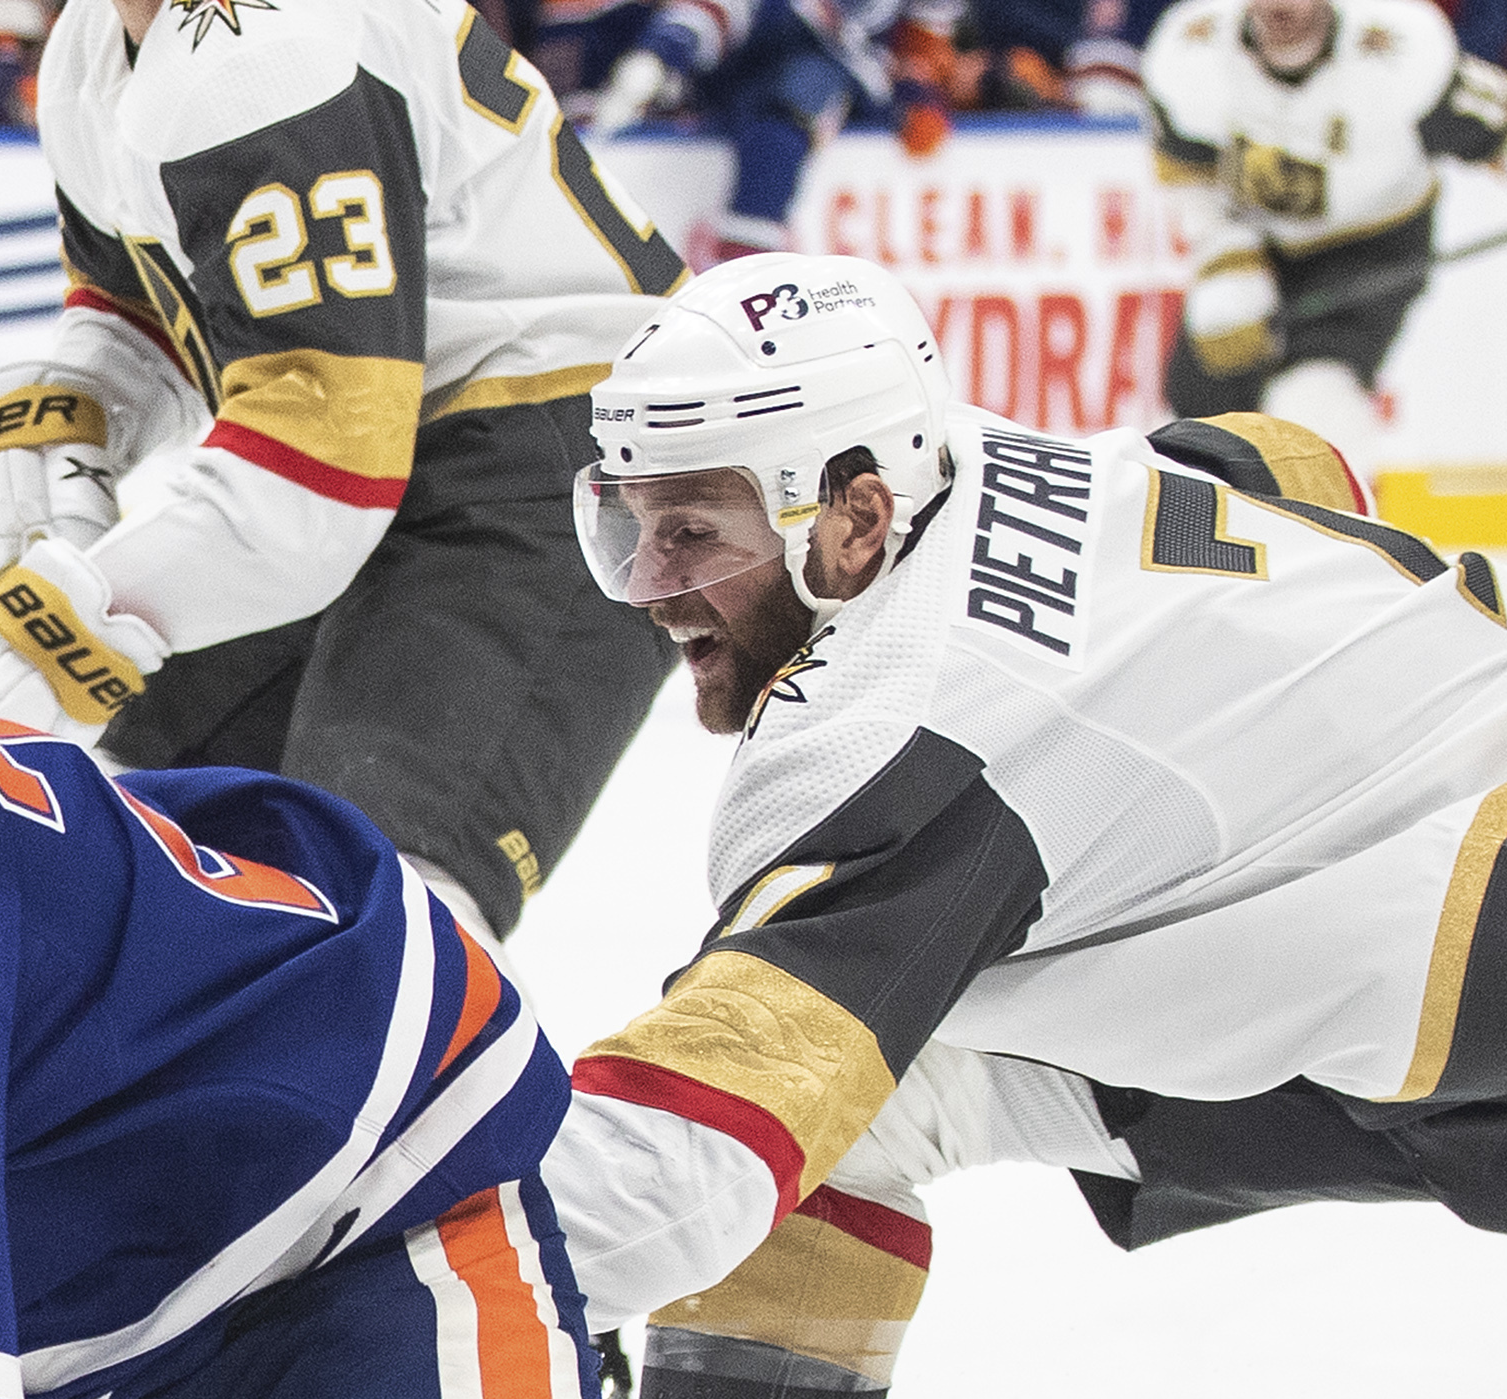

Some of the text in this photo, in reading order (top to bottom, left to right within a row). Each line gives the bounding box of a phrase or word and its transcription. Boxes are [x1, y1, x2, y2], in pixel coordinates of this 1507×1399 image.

[226, 169, 398, 319] 23
[740, 280, 877, 332] P3 Health Partners
[967, 426, 1093, 657] PIETRA
